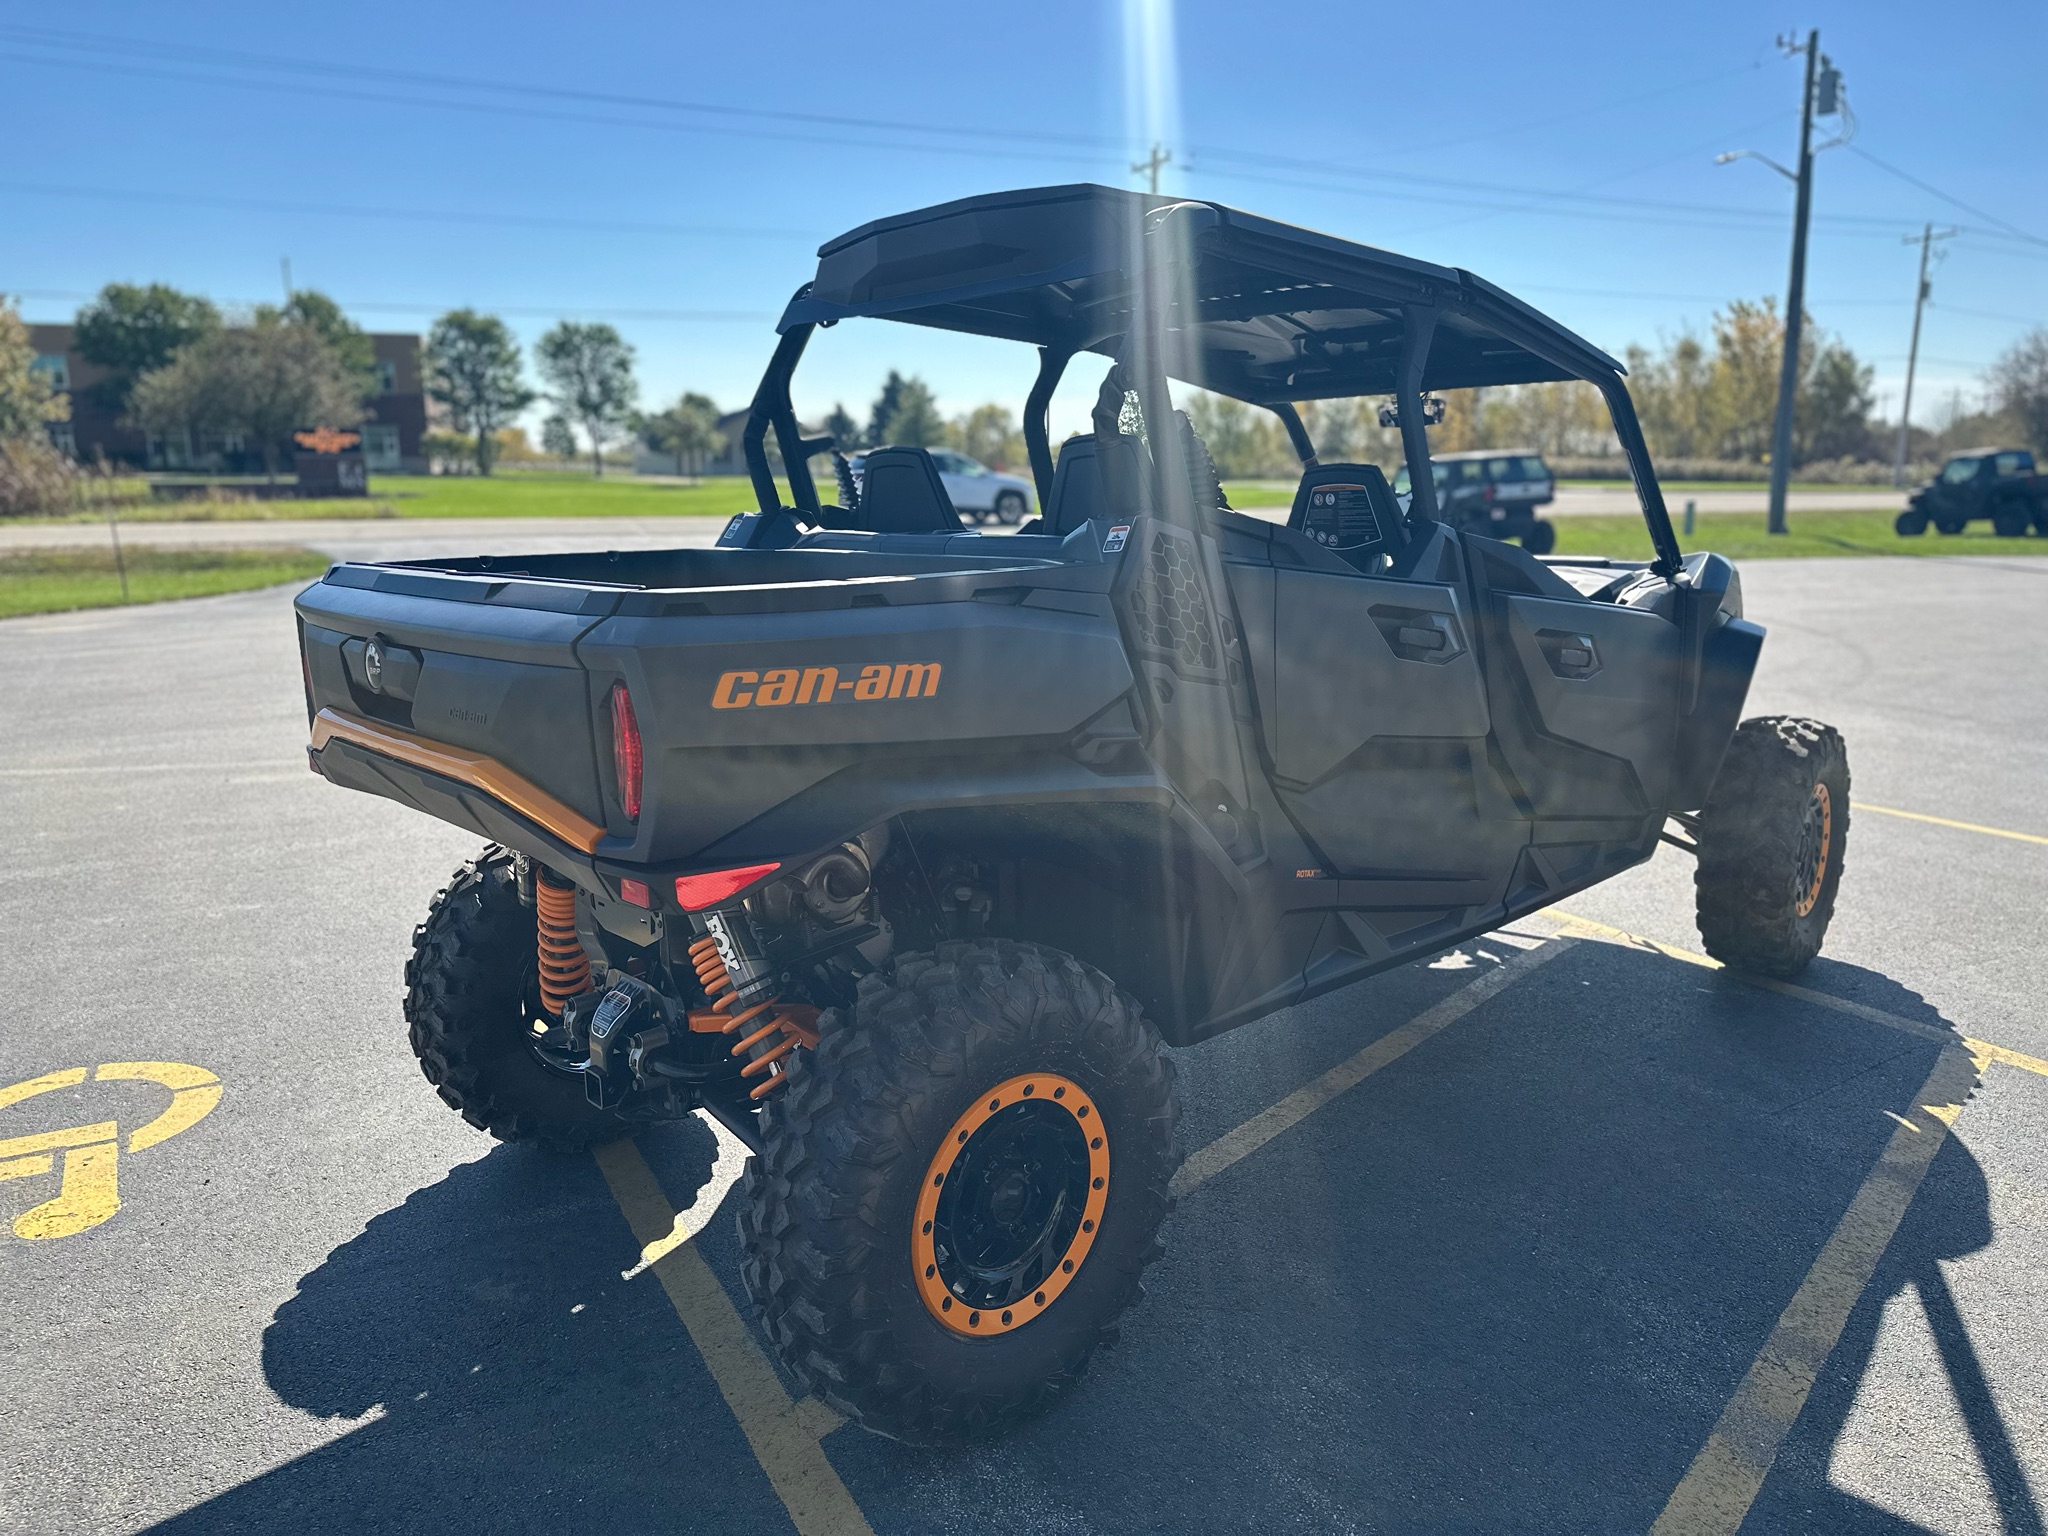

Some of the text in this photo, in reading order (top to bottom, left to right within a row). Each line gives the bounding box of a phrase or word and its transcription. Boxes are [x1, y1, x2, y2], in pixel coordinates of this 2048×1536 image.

[711, 662, 942, 710] can-am
[1296, 869, 1315, 878] ROTAX
[706, 914, 741, 975] FOX
